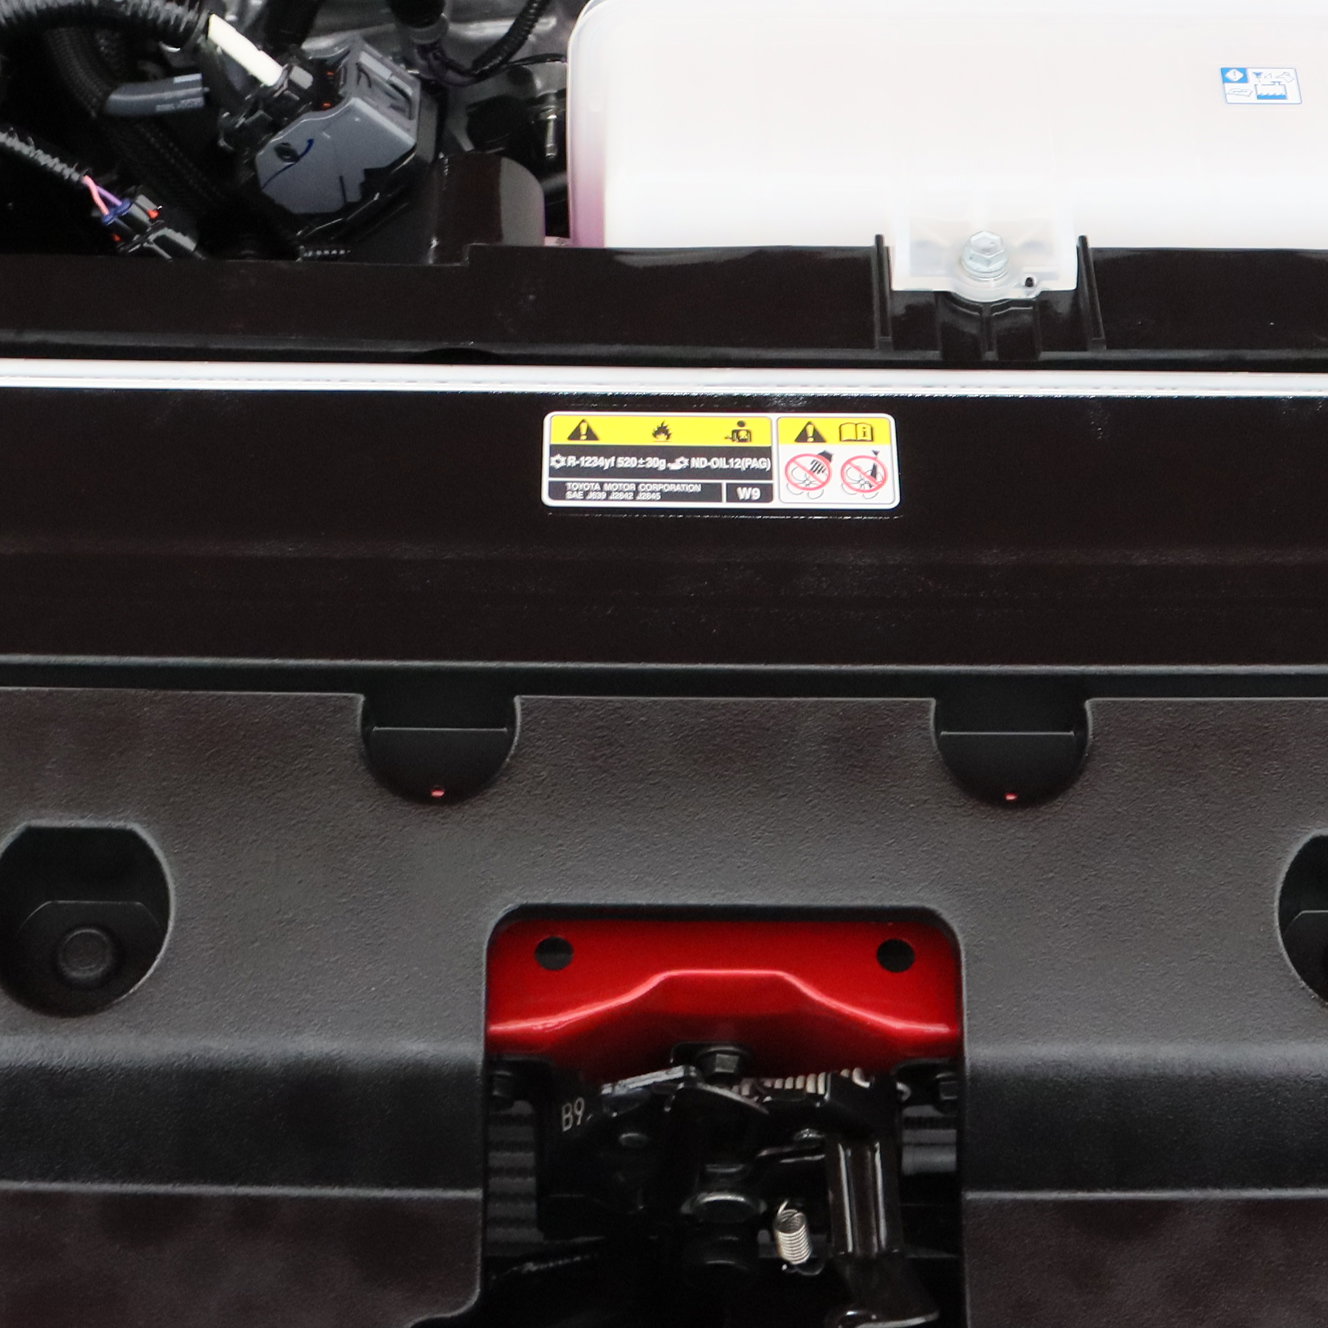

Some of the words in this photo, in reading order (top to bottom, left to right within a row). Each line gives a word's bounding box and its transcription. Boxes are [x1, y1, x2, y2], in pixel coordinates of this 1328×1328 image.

[567, 455, 615, 471] R-1234yf
[615, 456, 667, 472] 520±30g
[690, 457, 771, 472] ND-OIL12(PAG)
[565, 482, 601, 492] TOYOTA
[602, 482, 637, 492] MOTOR
[637, 483, 702, 493] CORPORATION
[565, 491, 584, 501] SAE
[736, 487, 761, 501] W9
